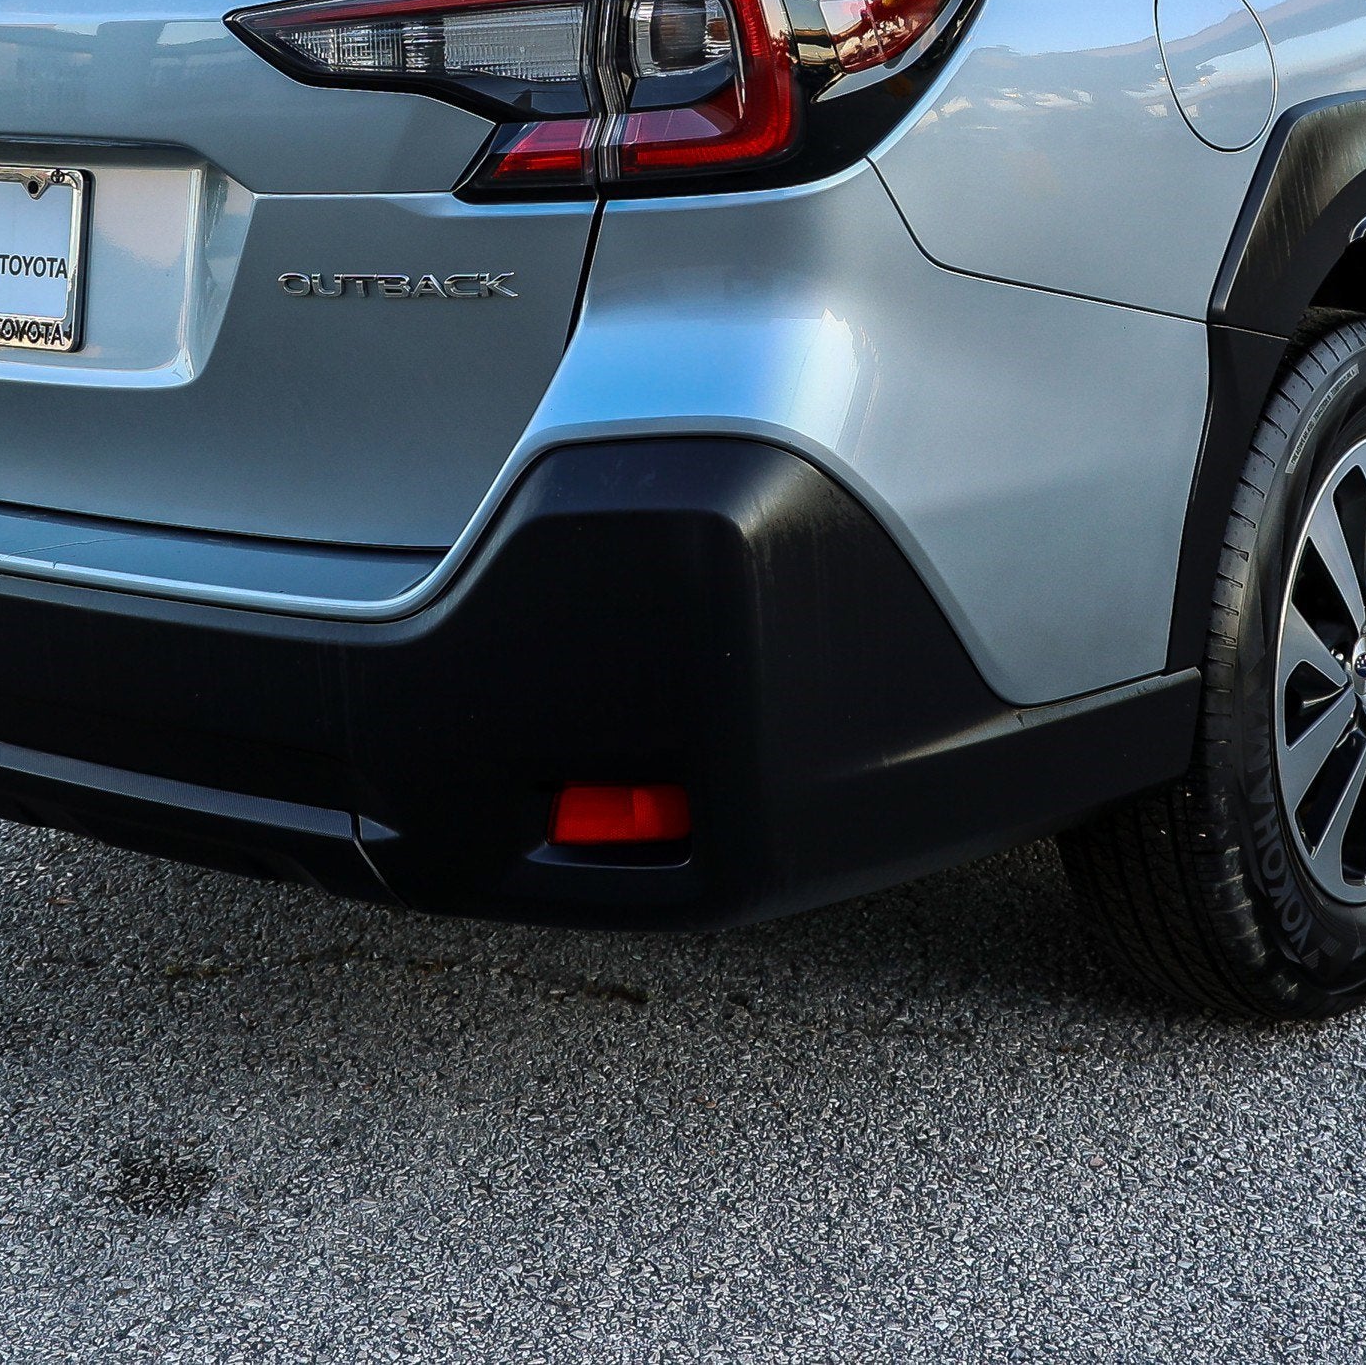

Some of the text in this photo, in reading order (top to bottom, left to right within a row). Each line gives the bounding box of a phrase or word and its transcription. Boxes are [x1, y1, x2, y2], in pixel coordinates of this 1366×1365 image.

[0, 254, 68, 278] TOYOTA
[277, 272, 518, 297] OUTBACK
[1245, 686, 1315, 955] YOKOHAMA
